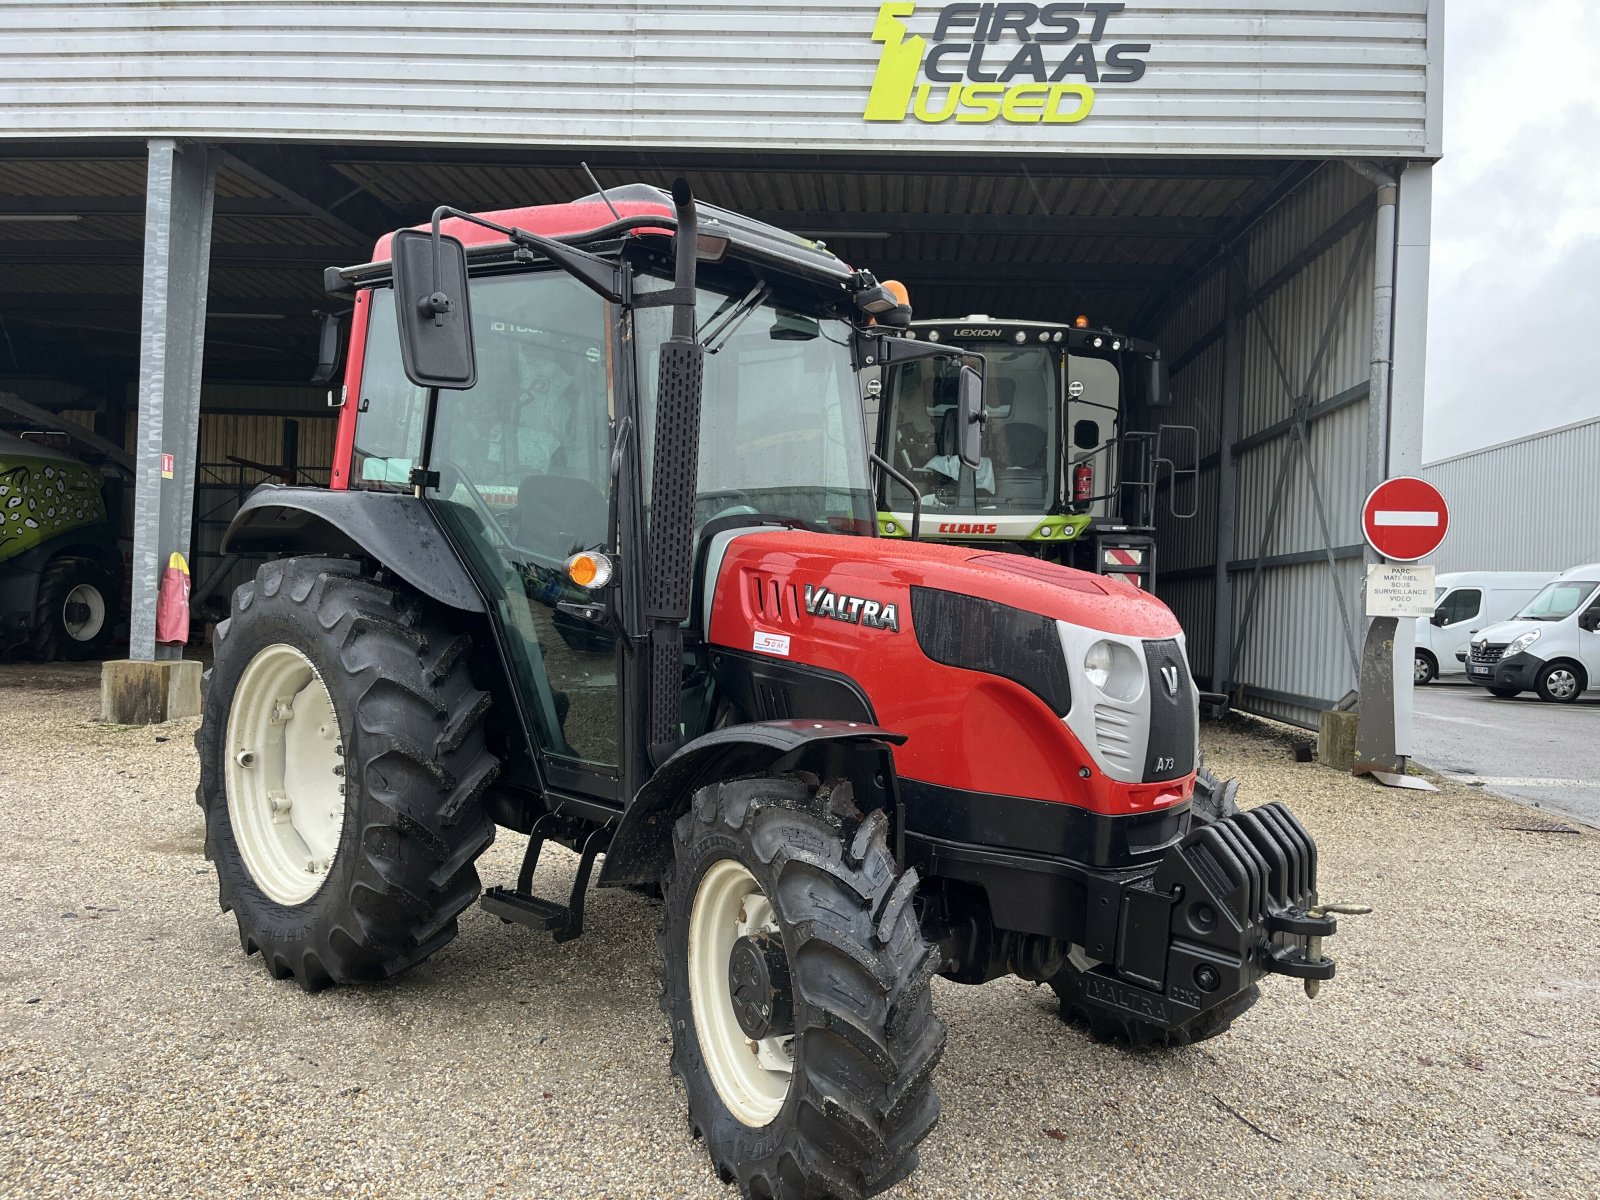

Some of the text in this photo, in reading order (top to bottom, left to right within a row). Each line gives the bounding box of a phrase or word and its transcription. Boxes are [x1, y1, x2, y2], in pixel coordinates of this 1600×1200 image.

[933, 3, 1125, 41] FIRST
[924, 43, 1151, 82] CLAAS
[913, 83, 1095, 123] USED
[953, 328, 1002, 337] LEXION
[938, 523, 997, 534] CLAAS
[804, 584, 899, 632] VALTRA
